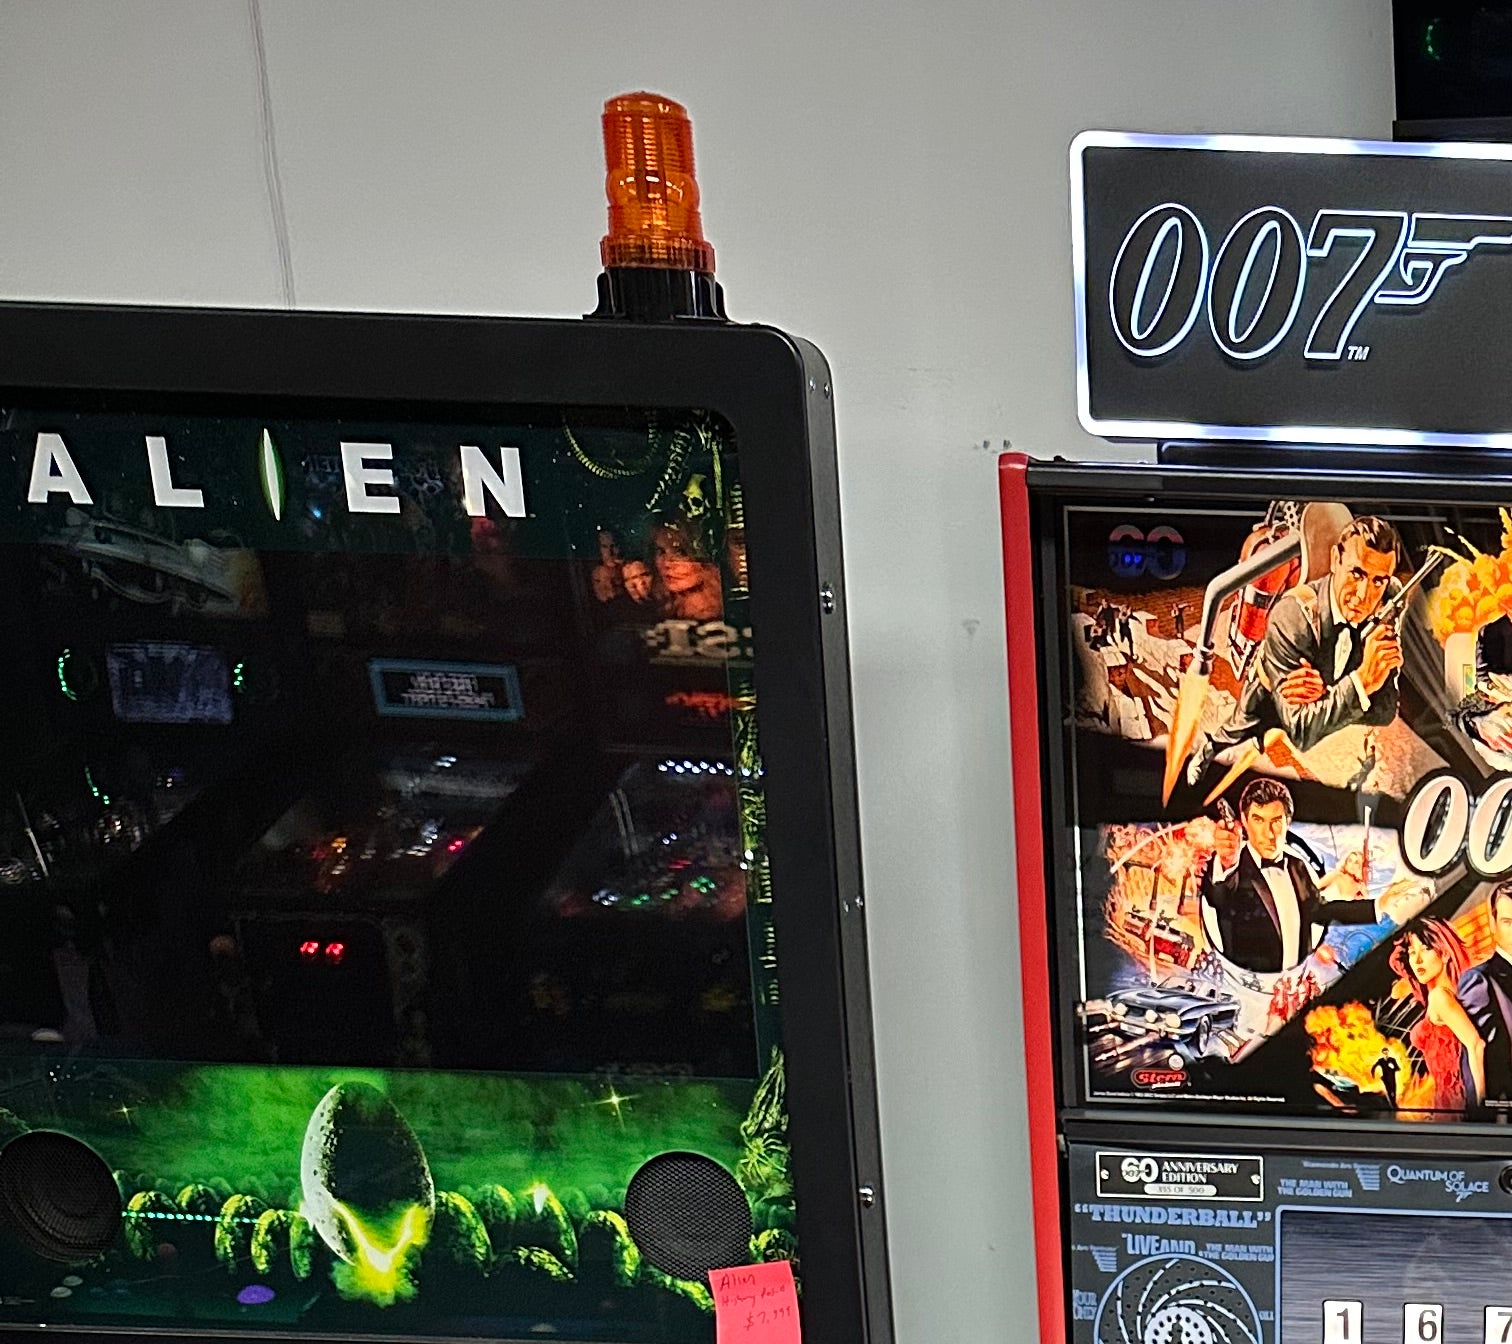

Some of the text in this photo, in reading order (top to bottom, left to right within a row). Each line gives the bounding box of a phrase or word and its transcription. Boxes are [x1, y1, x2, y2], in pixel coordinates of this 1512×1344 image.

[1121, 1157, 1239, 1183] 60 ANNIVERSARY
[1162, 1172, 1207, 1183] EDITION
[1445, 1181, 1489, 1193] SOLACE
